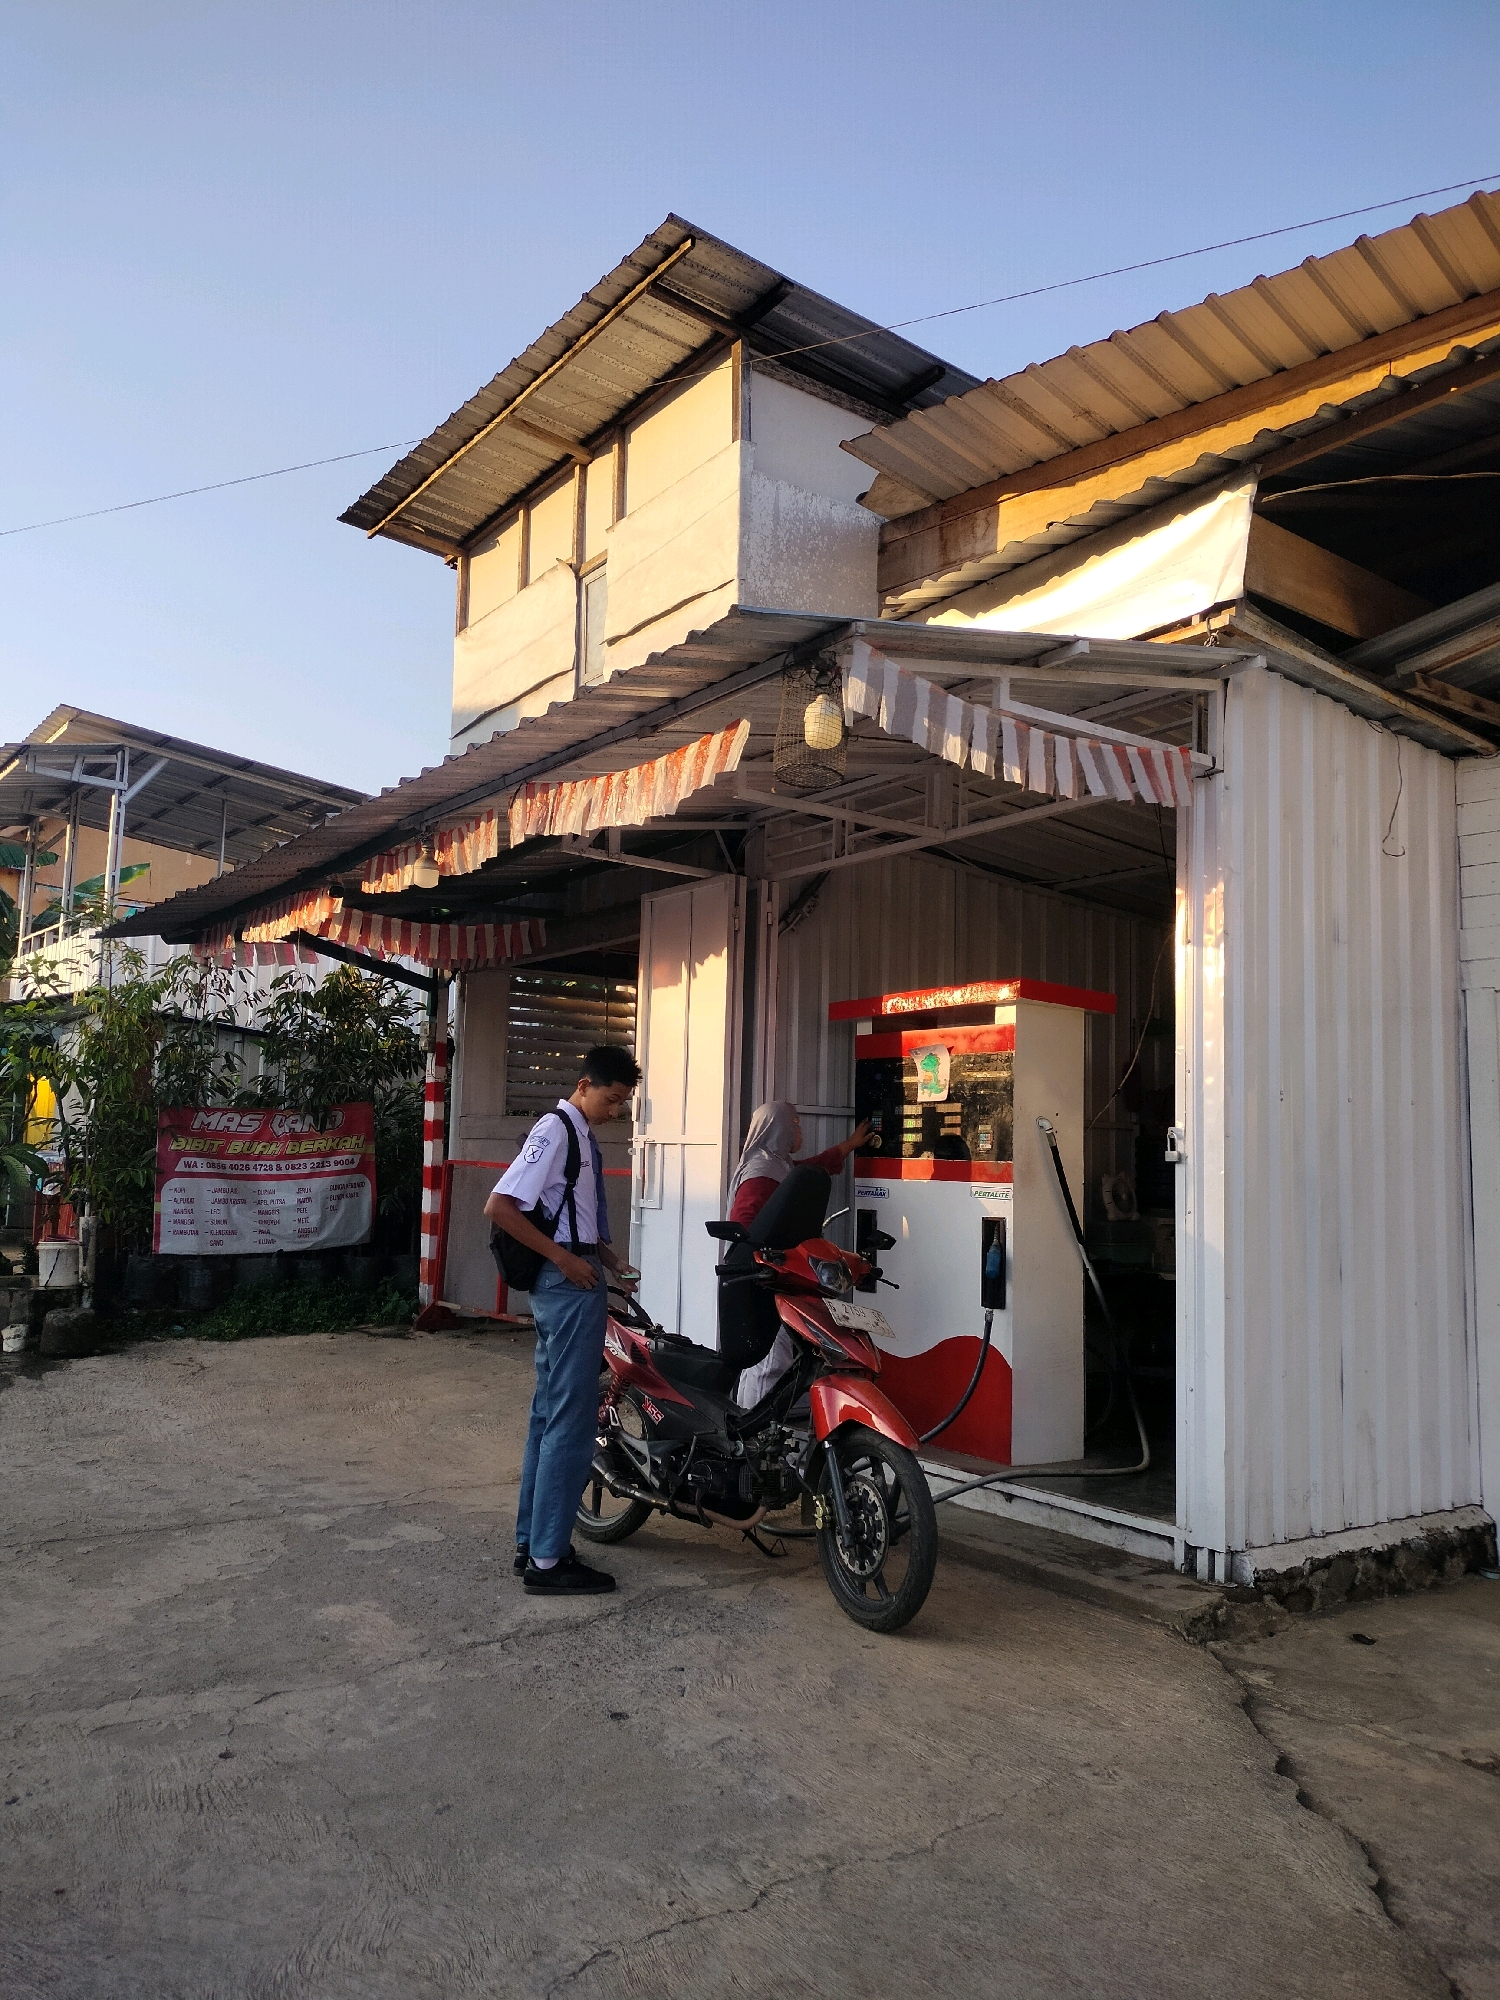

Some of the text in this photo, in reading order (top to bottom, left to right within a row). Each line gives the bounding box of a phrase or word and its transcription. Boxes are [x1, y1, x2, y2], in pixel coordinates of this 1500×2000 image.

[191, 1108, 345, 1138] MAS LAND
[168, 1135, 365, 1156] BIBIT BUAH BERKAH
[184, 1161, 198, 1169] WA
[229, 1163, 250, 1171] 4026
[275, 1163, 283, 1172] &
[285, 1162, 307, 1171] 0823
[974, 1190, 1010, 1198] PERTALITE
